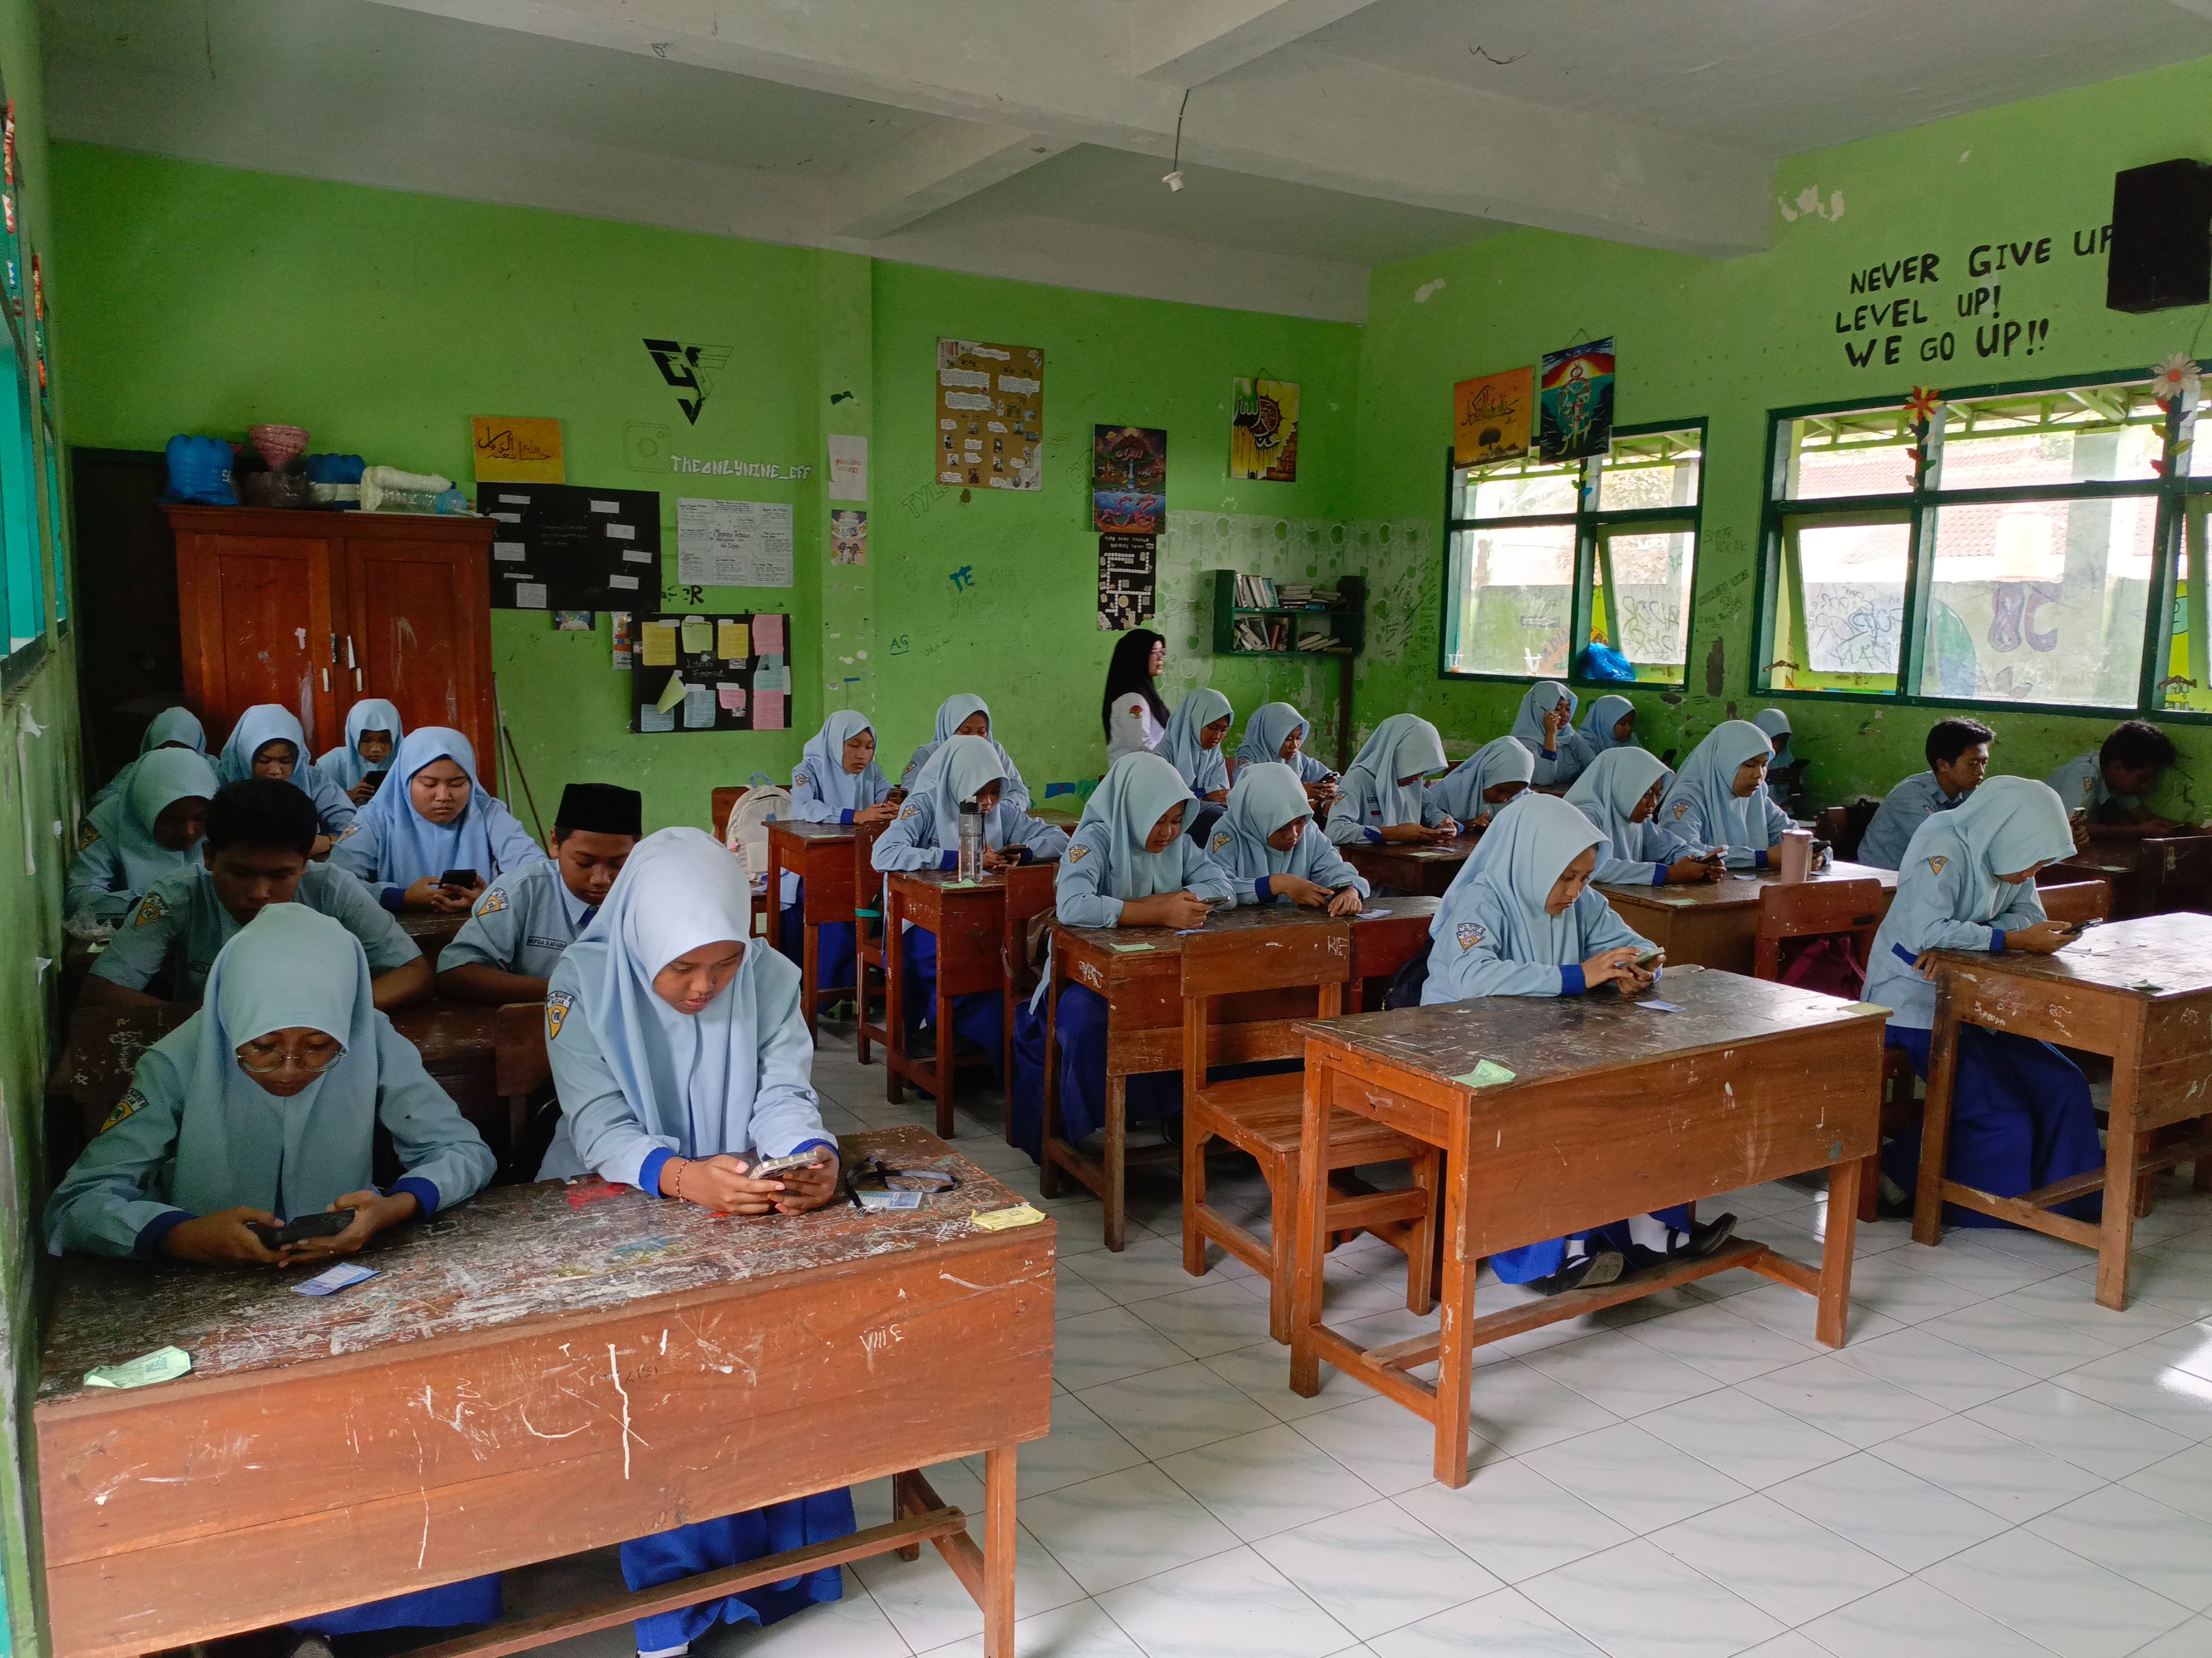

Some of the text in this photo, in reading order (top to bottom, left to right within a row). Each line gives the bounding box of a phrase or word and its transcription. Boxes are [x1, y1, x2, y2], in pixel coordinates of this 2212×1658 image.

[1849, 253, 1940, 294] NEVER
[1968, 237, 2052, 277] GIVE
[1835, 284, 2001, 333] LEVEL UP!
[1845, 318, 2049, 368] WE GO UP!!
